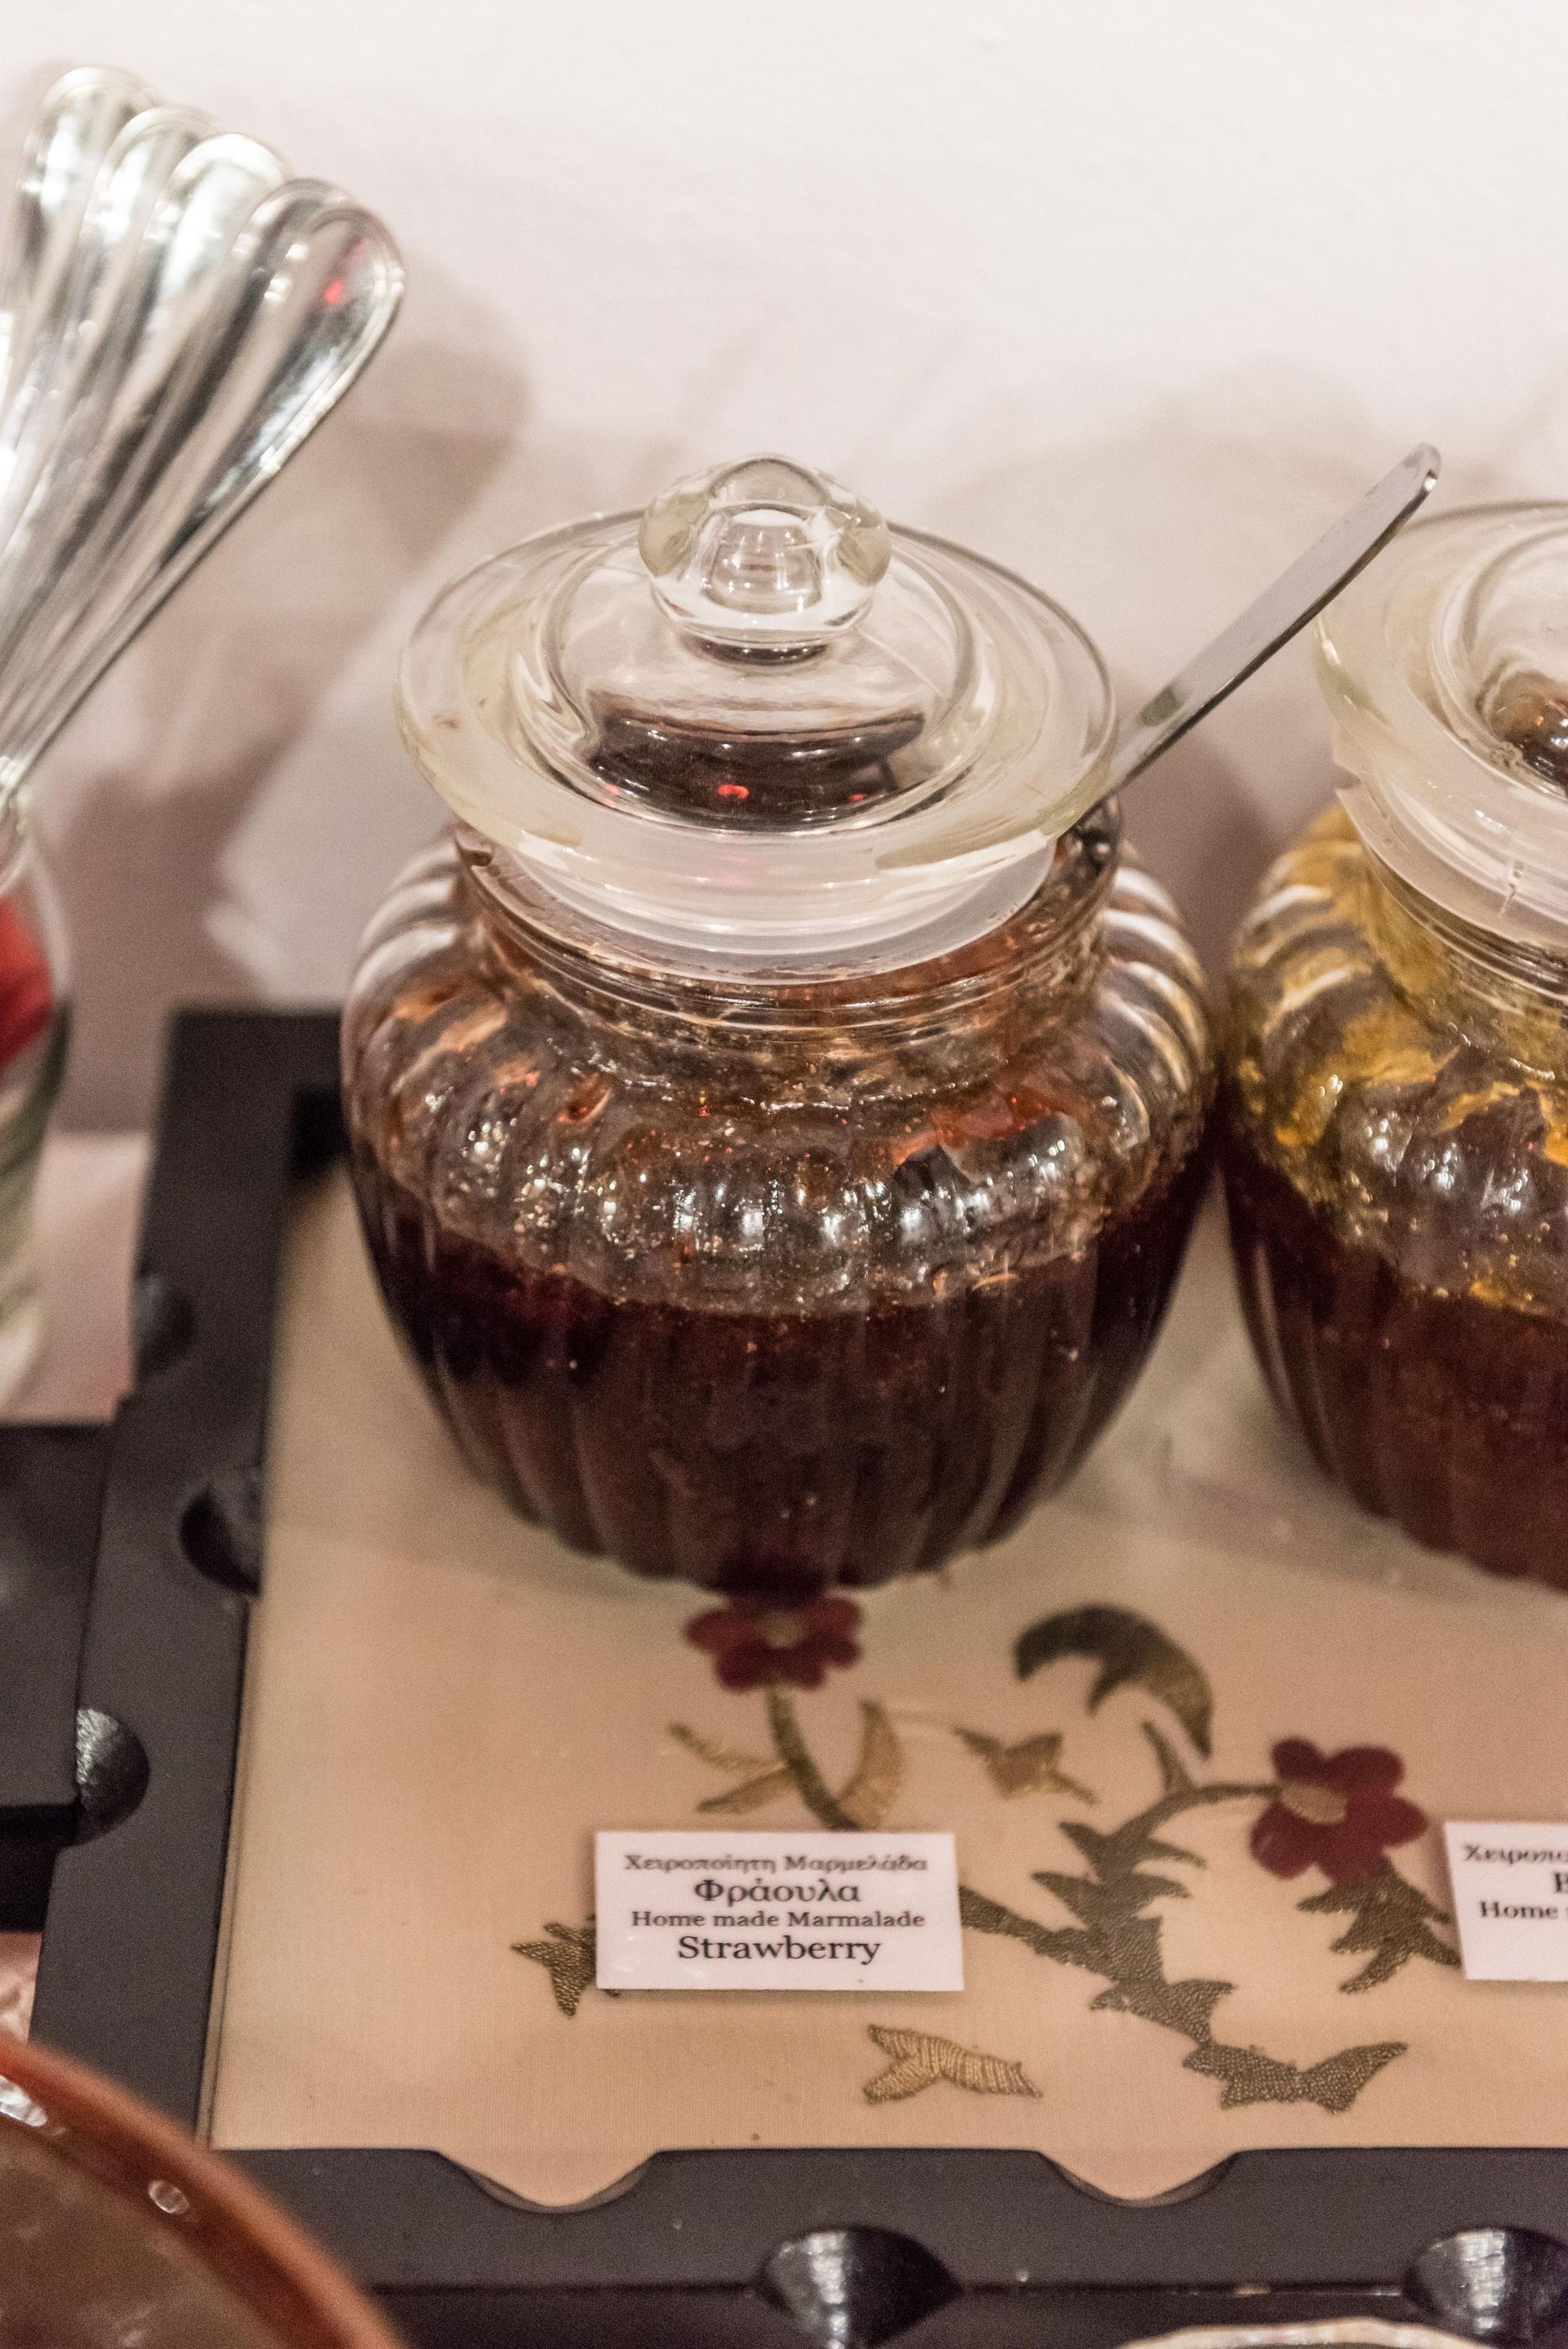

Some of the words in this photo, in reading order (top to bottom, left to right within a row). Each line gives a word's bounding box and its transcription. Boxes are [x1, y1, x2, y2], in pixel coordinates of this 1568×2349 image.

[784, 1854, 928, 1874] Μαρμελάδα
[694, 1879, 862, 1907] Φράουλα
[631, 1910, 705, 1928] Home
[713, 1910, 780, 1928] made
[787, 1910, 925, 1928] Marmalade
[1480, 1900, 1558, 1919] Home
[678, 1935, 881, 1965] Strawberry
